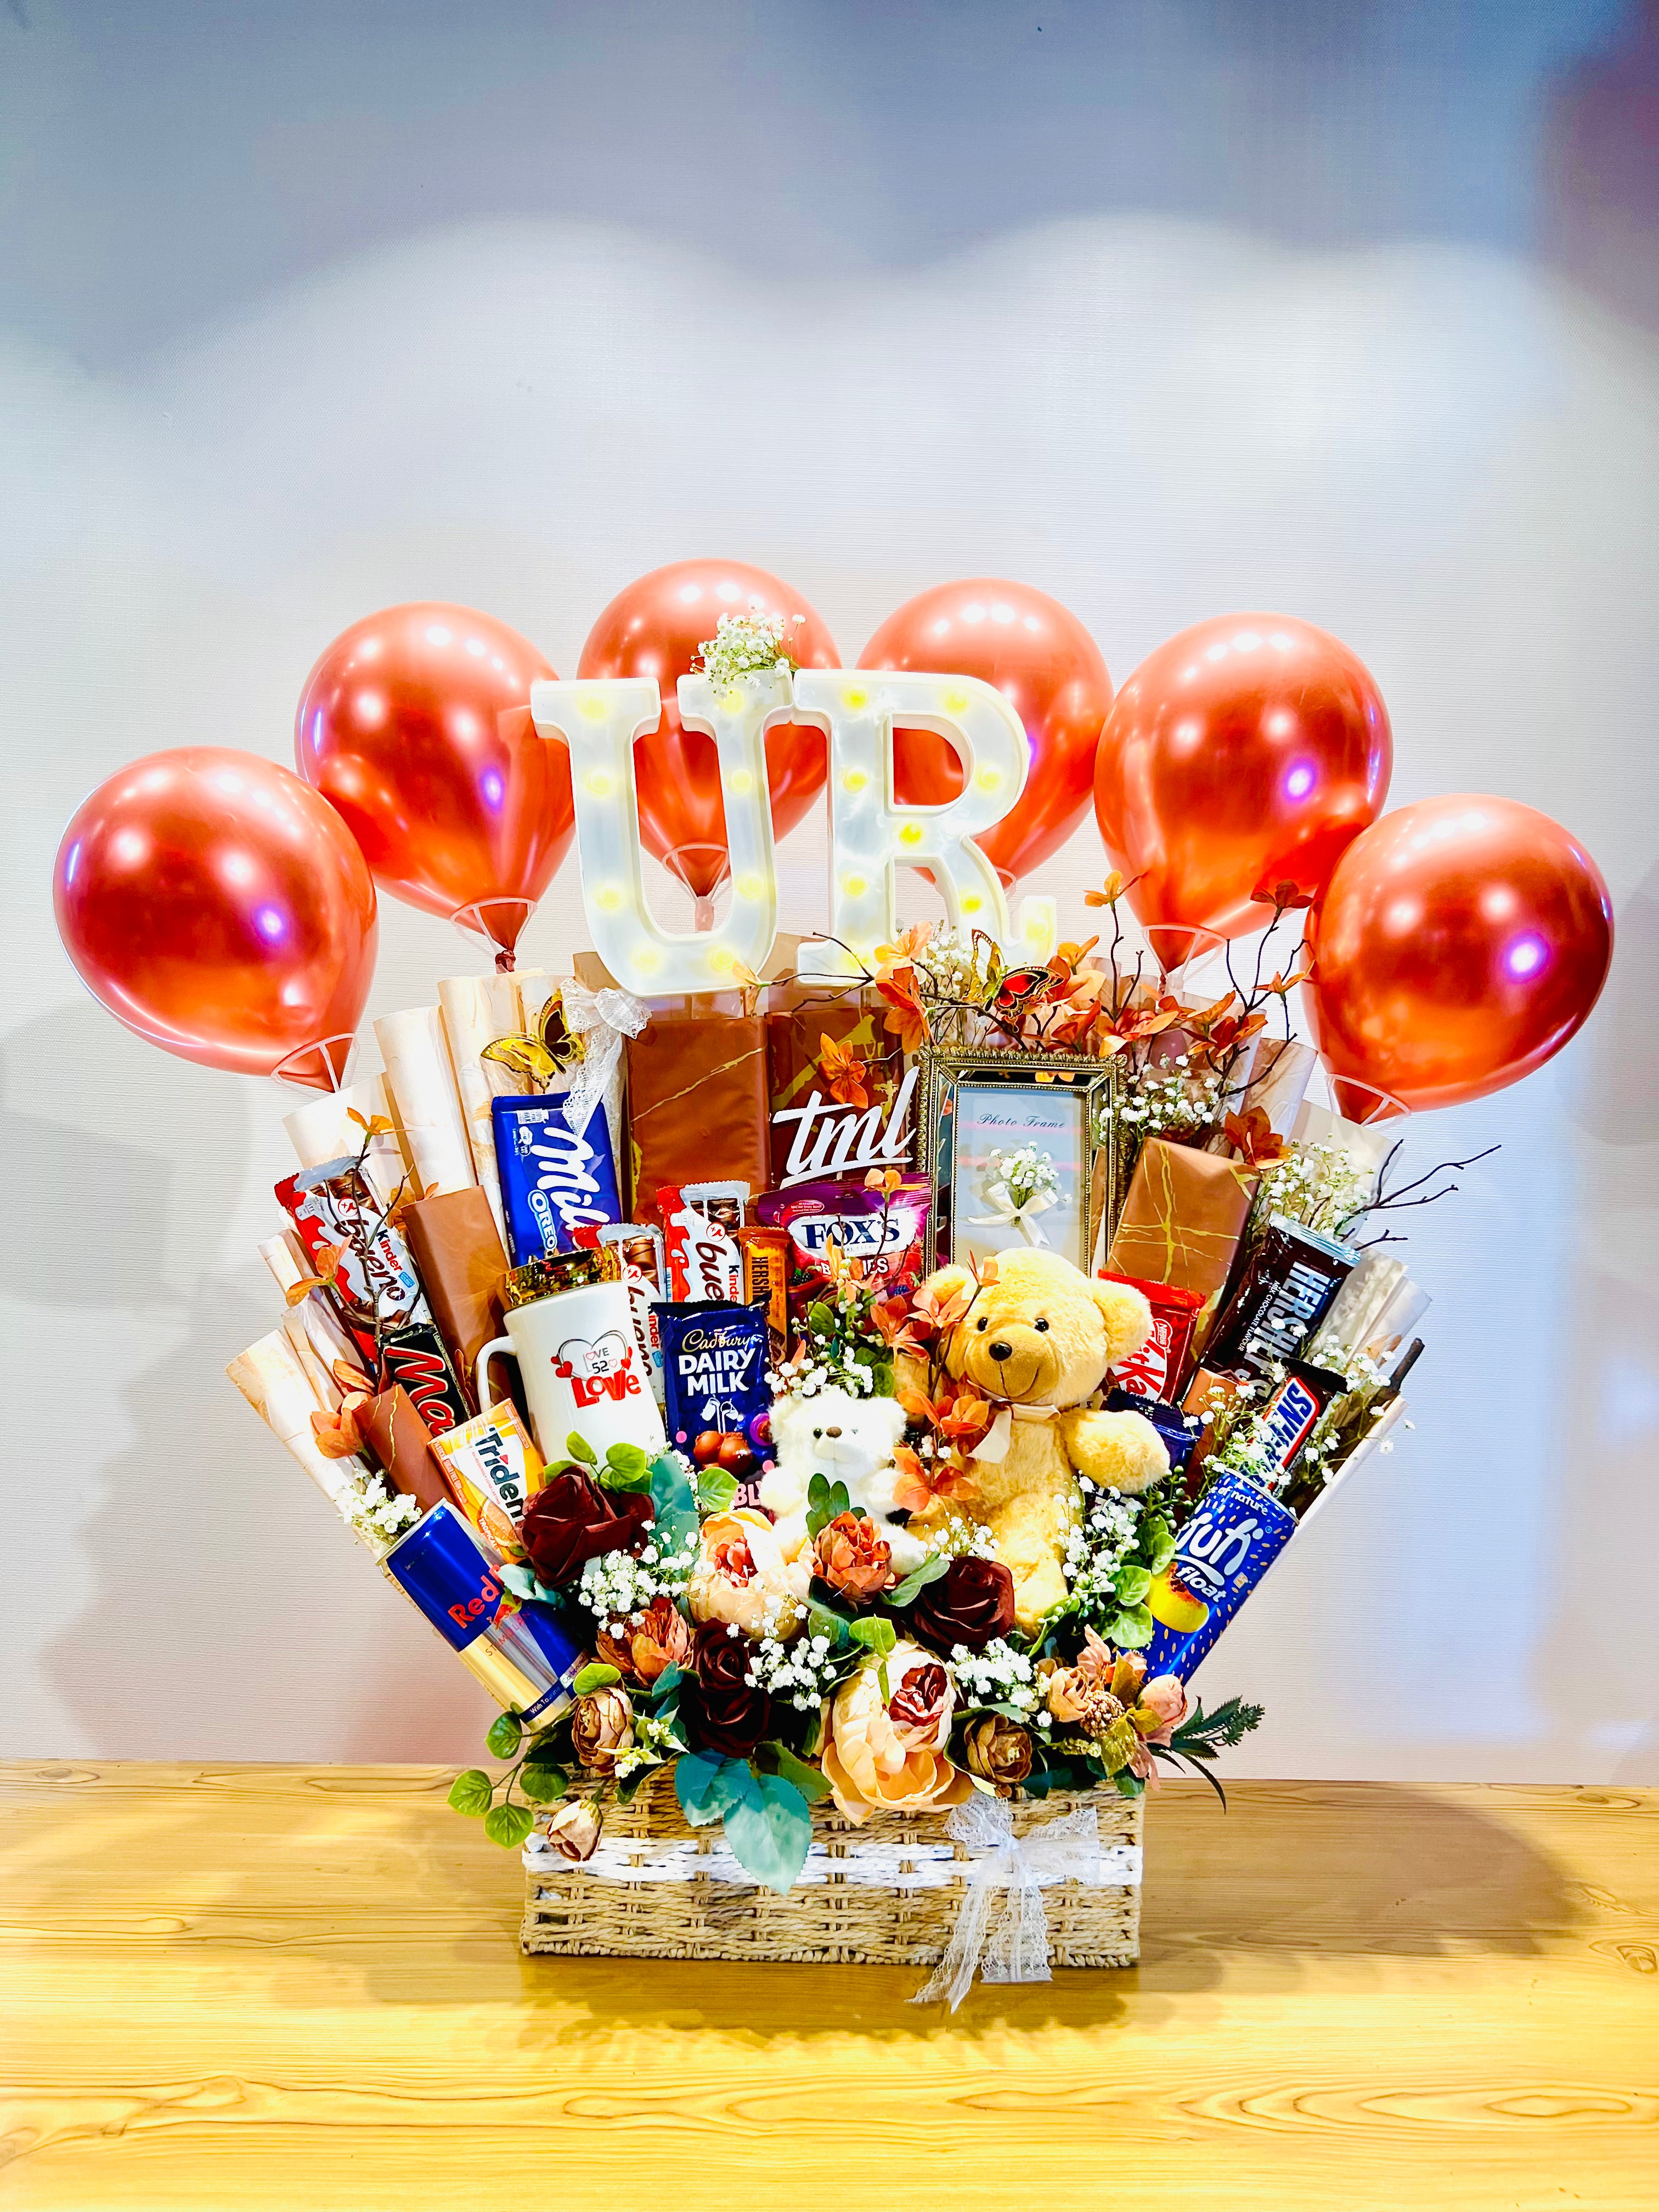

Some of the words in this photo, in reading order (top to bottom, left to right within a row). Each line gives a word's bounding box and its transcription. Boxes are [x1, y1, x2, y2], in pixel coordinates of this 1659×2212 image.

[531, 669, 1057, 997] UR
[772, 1066, 920, 1176] tml
[977, 1113, 1018, 1126] Photo
[1023, 1115, 1066, 1128] Frame
[531, 1127, 610, 1232] Mil
[530, 1193, 557, 1250] OREO
[801, 1219, 900, 1249] FOX'S
[696, 1243, 727, 1300] bue
[821, 1257, 888, 1276] BIES
[729, 1265, 740, 1302] Kinde
[1268, 1280, 1280, 1295] MILK
[1251, 1293, 1273, 1326] CHOCOLATE
[681, 1329, 751, 1351] Cadbury
[1237, 1324, 1257, 1352] FLAVOUR
[678, 1347, 756, 1375] DAIRY
[383, 1345, 456, 1437] Ma
[687, 1370, 749, 1396] MILK
[442, 1458, 455, 1474] SUGAR
[448, 1470, 459, 1482] FREE
[475, 1426, 525, 1525] Triden
[453, 1479, 464, 1491] GUM
[1217, 1486, 1233, 1497] of
[1230, 1489, 1269, 1516] nature
[478, 1516, 498, 1548] TROPICAL
[1175, 1565, 1227, 1602] float
[447, 1575, 500, 1629] Red
[530, 1702, 543, 1714] With
[540, 1686, 561, 1704] Taurine
